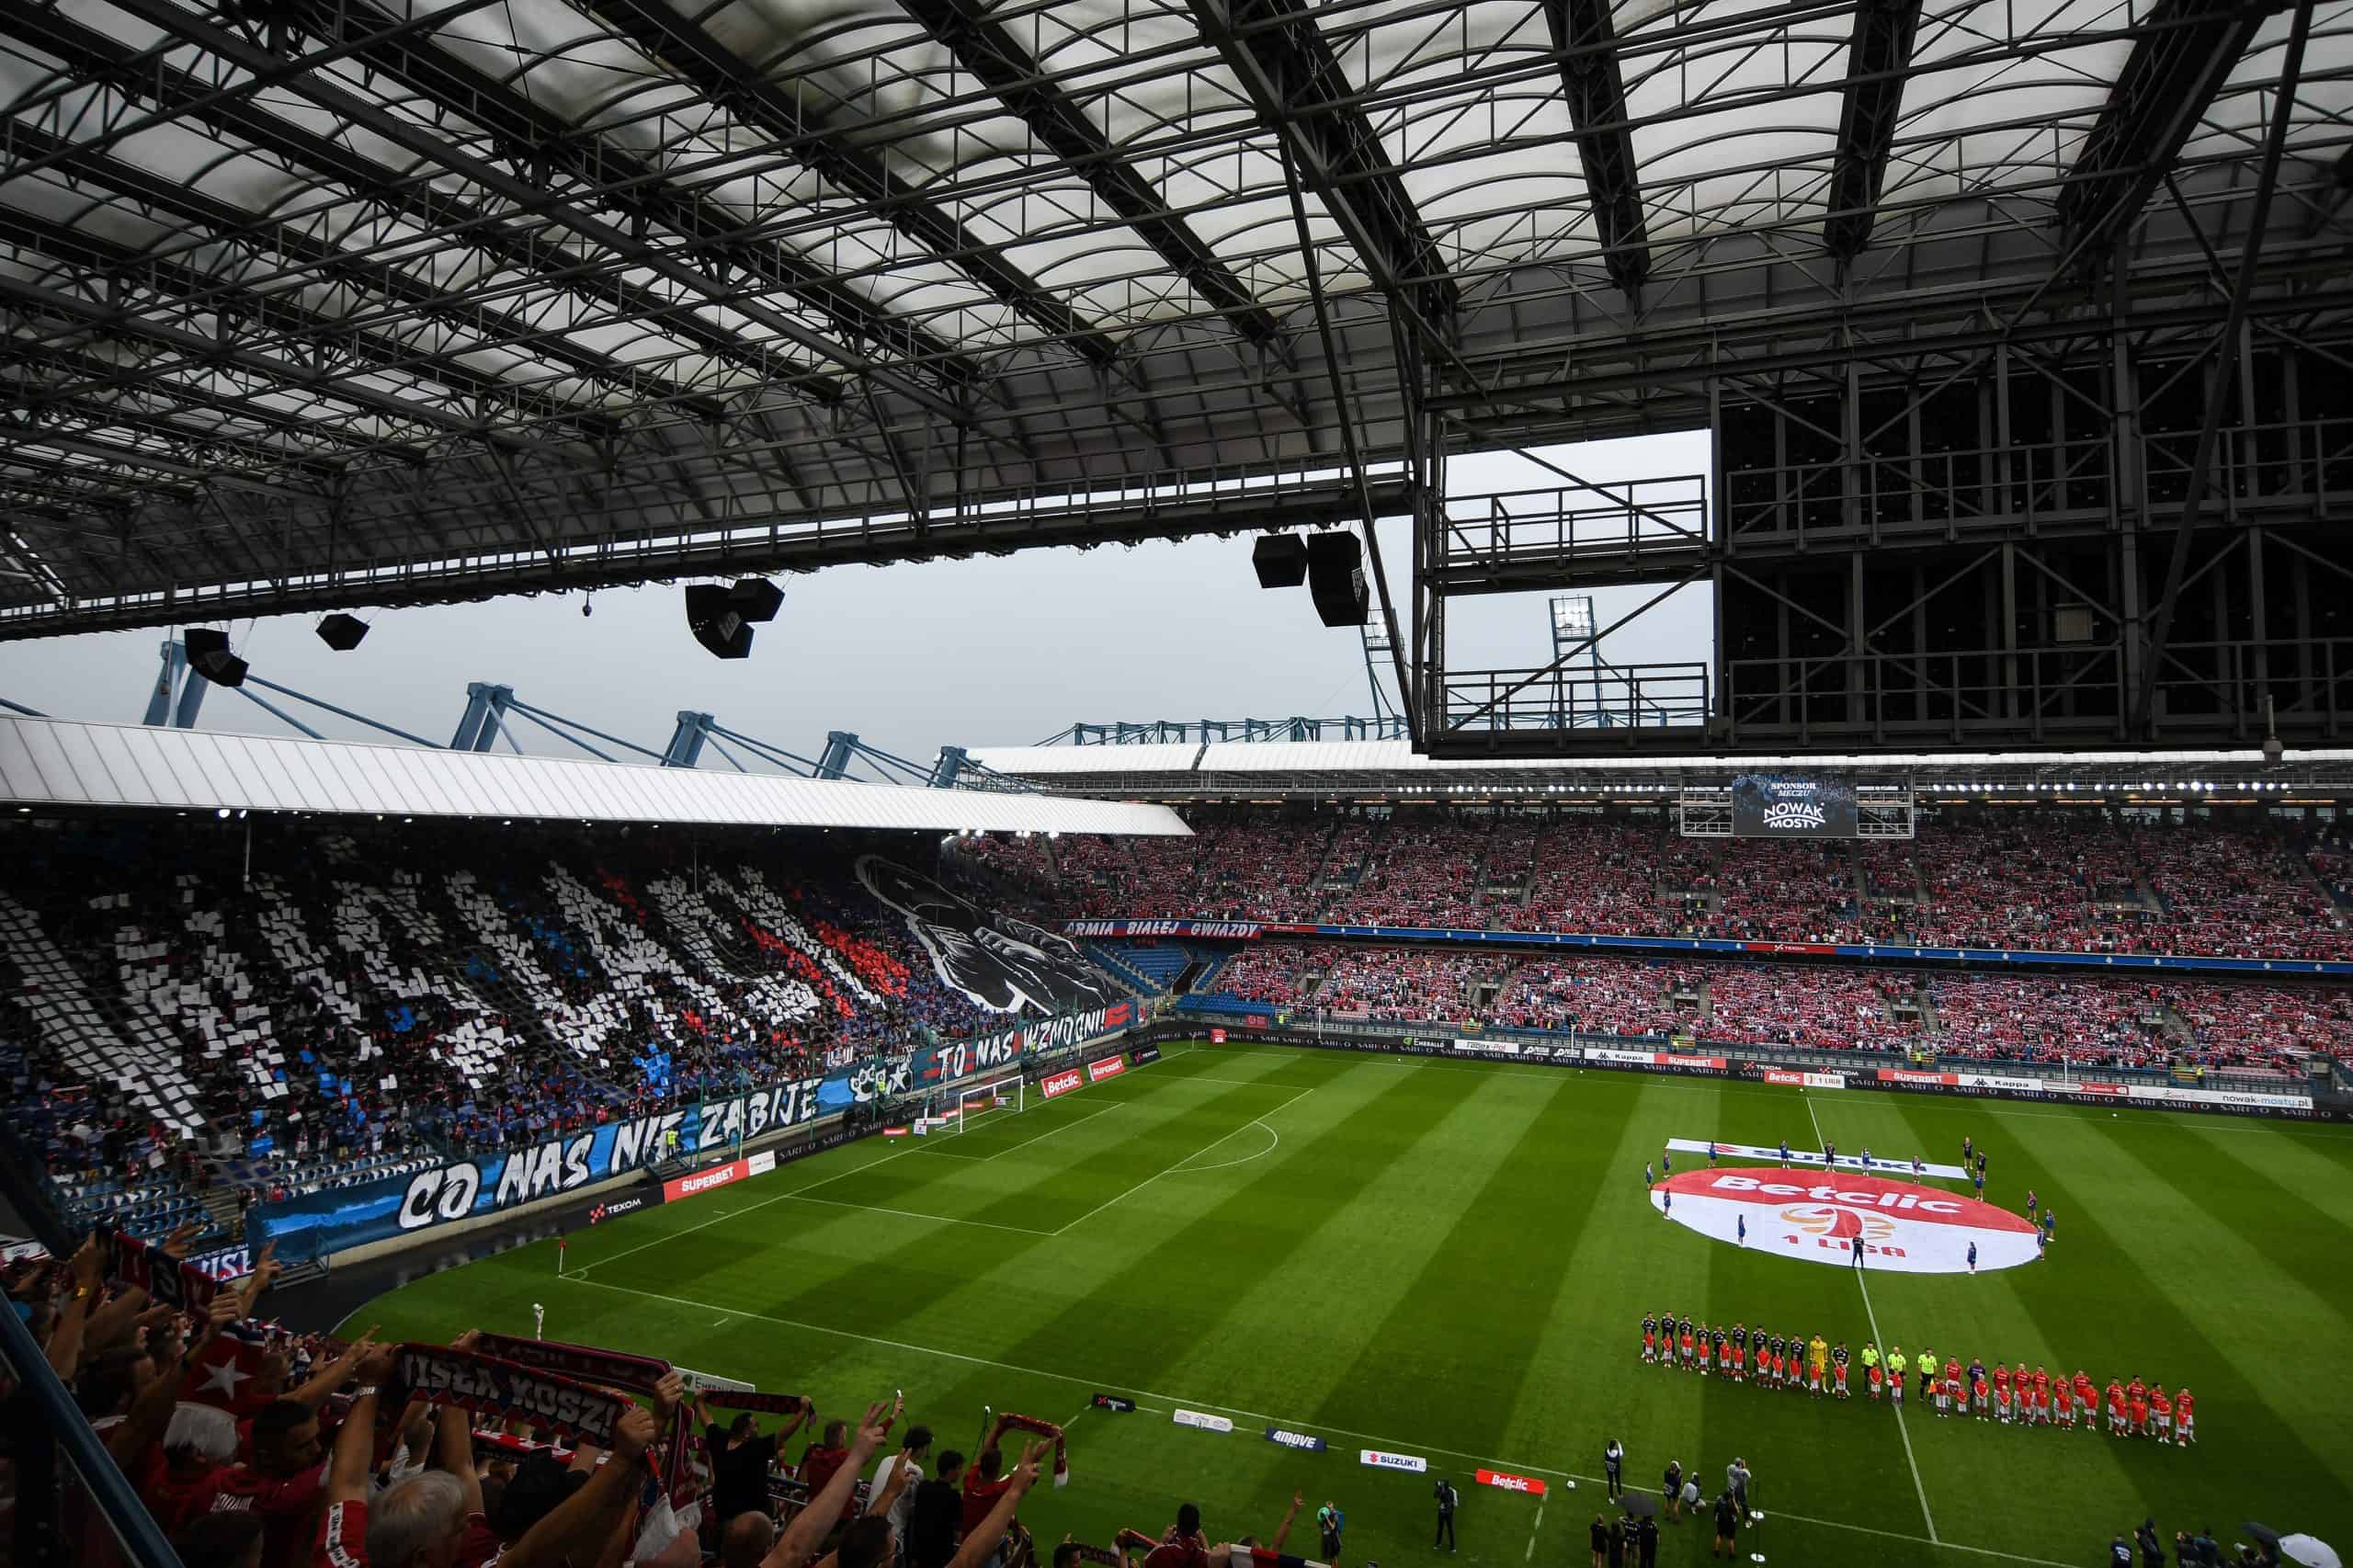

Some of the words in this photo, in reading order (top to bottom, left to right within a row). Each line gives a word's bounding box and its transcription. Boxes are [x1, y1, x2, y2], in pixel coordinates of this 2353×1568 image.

[1771, 782, 1816, 790] SPONSOR
[1765, 802, 1824, 819] NOWAK
[1770, 818, 1818, 829] MOSTY
[1064, 921, 1115, 936] ARMIA
[1126, 921, 1180, 935] BIAŁEJ
[1191, 922, 1258, 937] GWIAZDY
[937, 1043, 966, 1080] TO
[975, 1030, 1015, 1066] NAS
[1667, 1056, 1712, 1067] SUPERBET
[1093, 1061, 1123, 1075] SUPERBET
[1048, 1072, 1079, 1093] Betclic
[1768, 1073, 1800, 1084] Betclic
[1893, 1072, 1942, 1083] SUPERBET
[1995, 1080, 2029, 1088] Kappa
[398, 1163, 480, 1229] CO
[497, 1133, 594, 1205] NAS
[699, 1077, 825, 1148] ZABIJE
[680, 1165, 735, 1193] SUPERBET
[1710, 1176, 1963, 1214] Betclic
[606, 1198, 642, 1214] TEXOM
[1272, 1430, 1316, 1449] 4MOVE
[1380, 1454, 1418, 1470] SUZUKI
[1491, 1474, 1529, 1491] Betclic
